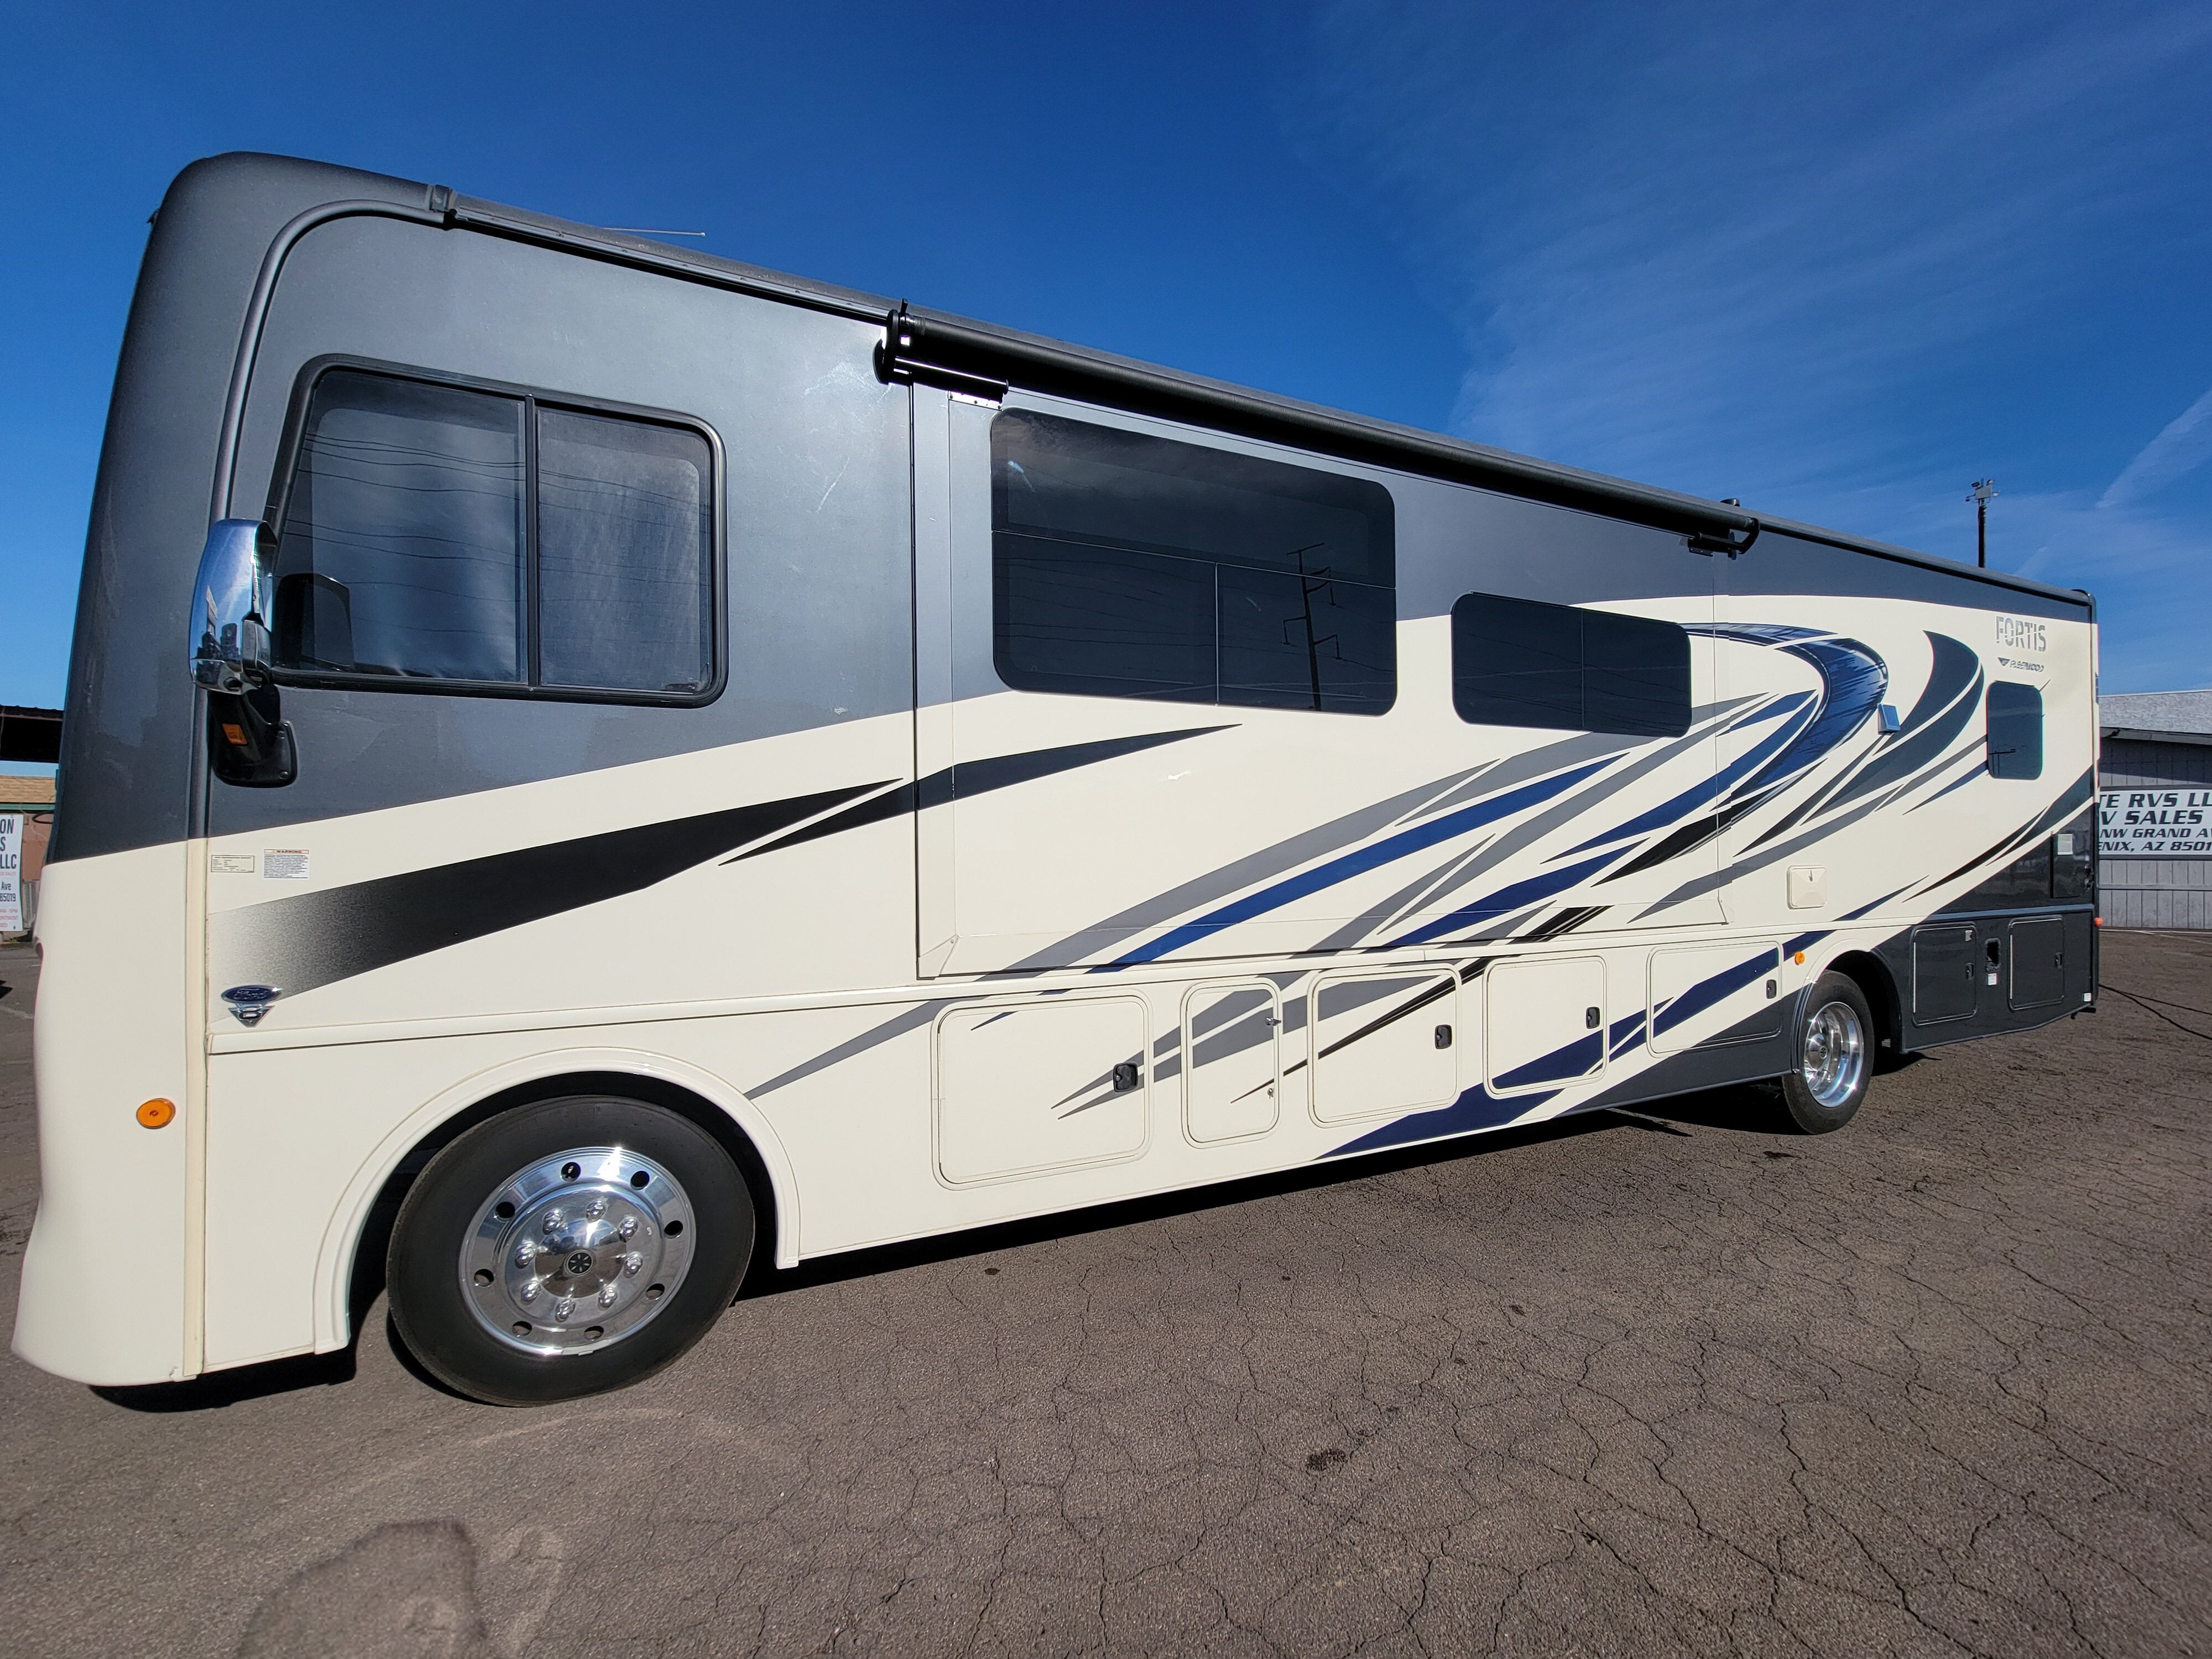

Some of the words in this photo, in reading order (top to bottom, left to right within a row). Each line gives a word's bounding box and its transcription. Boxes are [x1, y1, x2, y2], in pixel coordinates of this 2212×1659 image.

[1996, 615, 2046, 652] FORTIS
[2128, 793, 2178, 808] RVS
[2101, 811, 2118, 825] V
[2124, 810, 2204, 825] SALES
[2100, 829, 2128, 838] NW
[2132, 828, 2191, 838] GRAND
[2141, 842, 2166, 851] AZ
[0, 854, 17, 869] LLC
[234, 988, 269, 999] Ford
